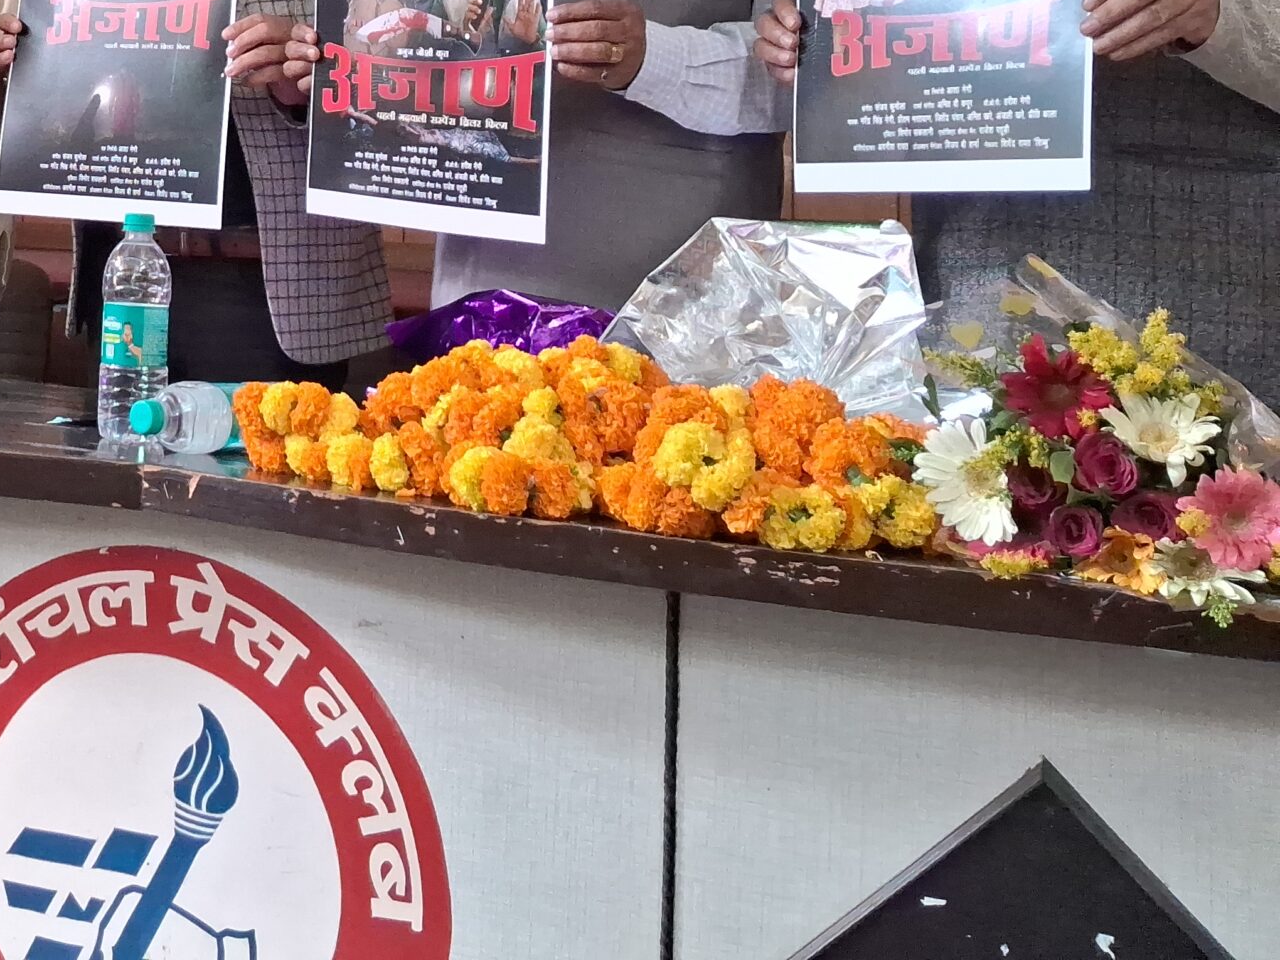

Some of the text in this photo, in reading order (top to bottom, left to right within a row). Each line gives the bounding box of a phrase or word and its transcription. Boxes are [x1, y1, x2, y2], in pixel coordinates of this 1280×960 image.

[321, 42, 546, 133] अजाण
[169, 562, 310, 687] प्रेस
[303, 667, 424, 932] क्लब
